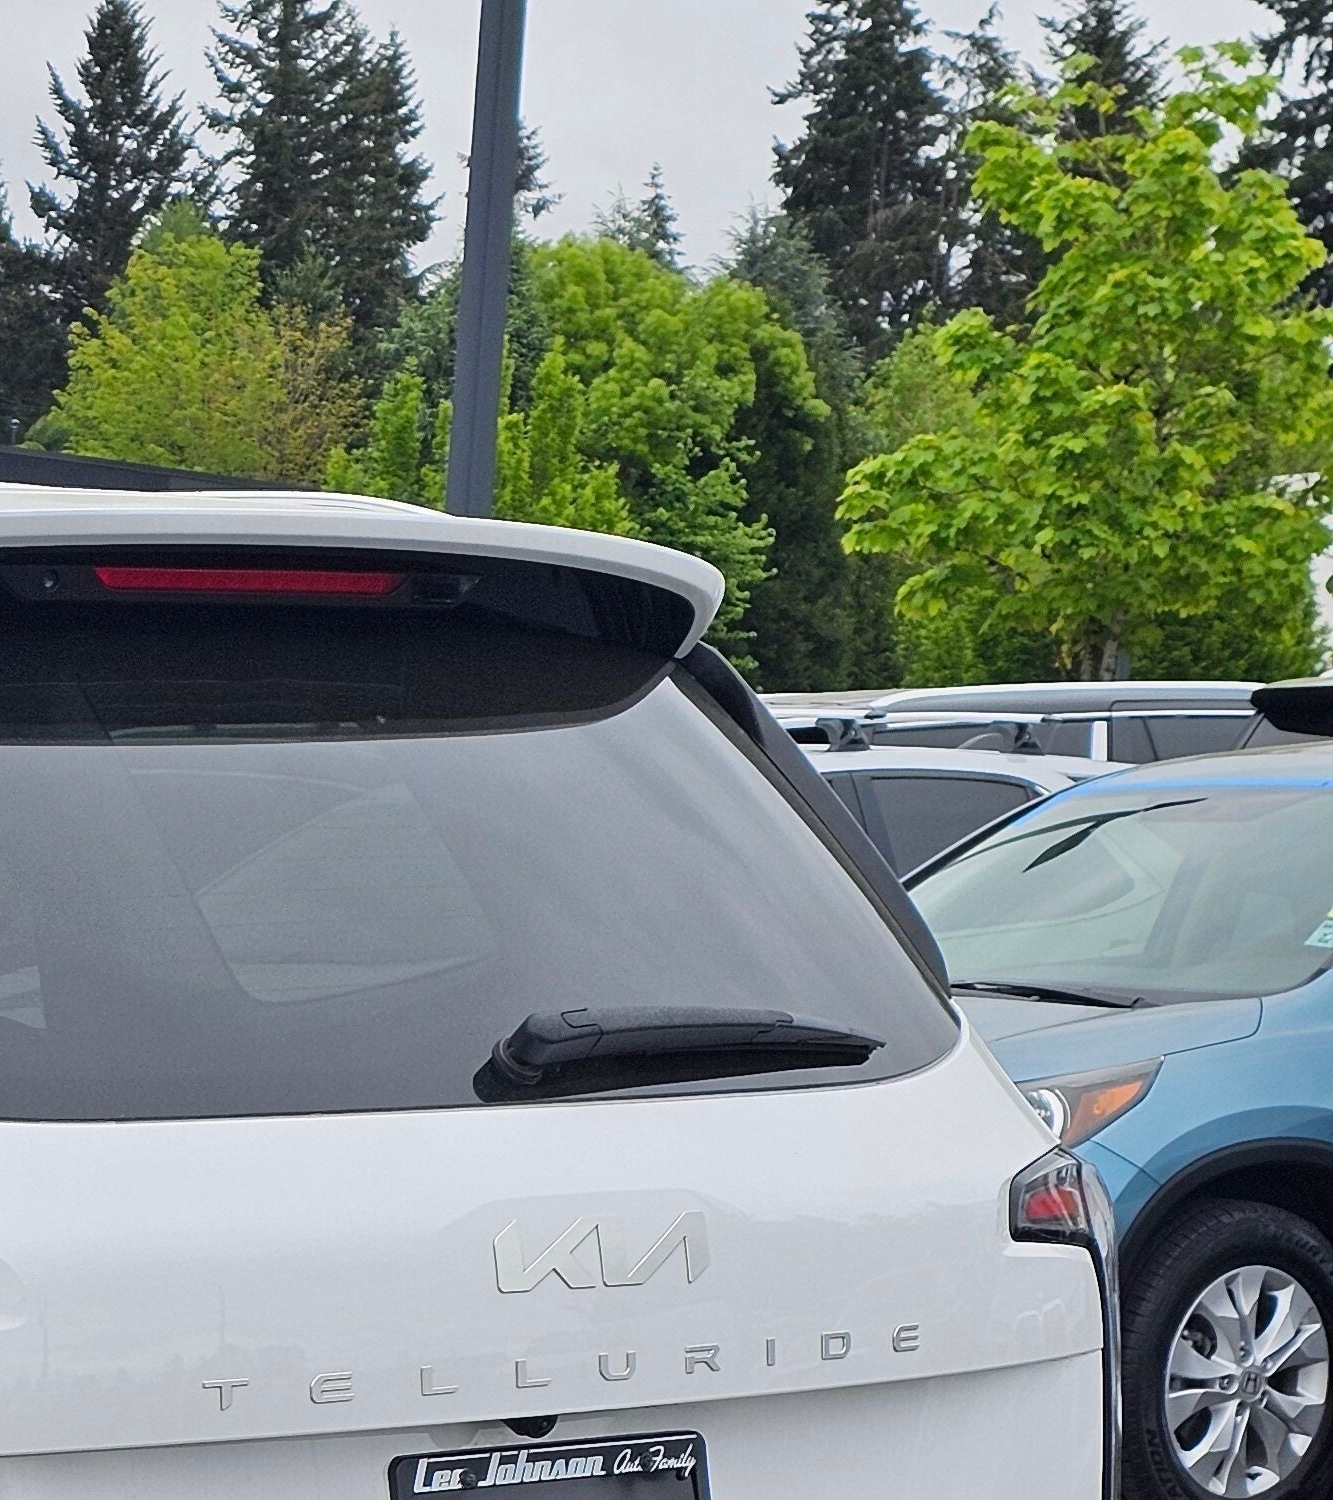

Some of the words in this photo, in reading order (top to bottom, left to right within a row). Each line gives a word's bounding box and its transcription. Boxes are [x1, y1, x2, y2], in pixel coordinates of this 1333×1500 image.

[493, 1211, 710, 1294] KIA
[202, 1323, 920, 1411] TELLURIDE
[477, 1450, 606, 1487] Johnson
[613, 1448, 643, 1474] Aut
[649, 1443, 697, 1477] Family
